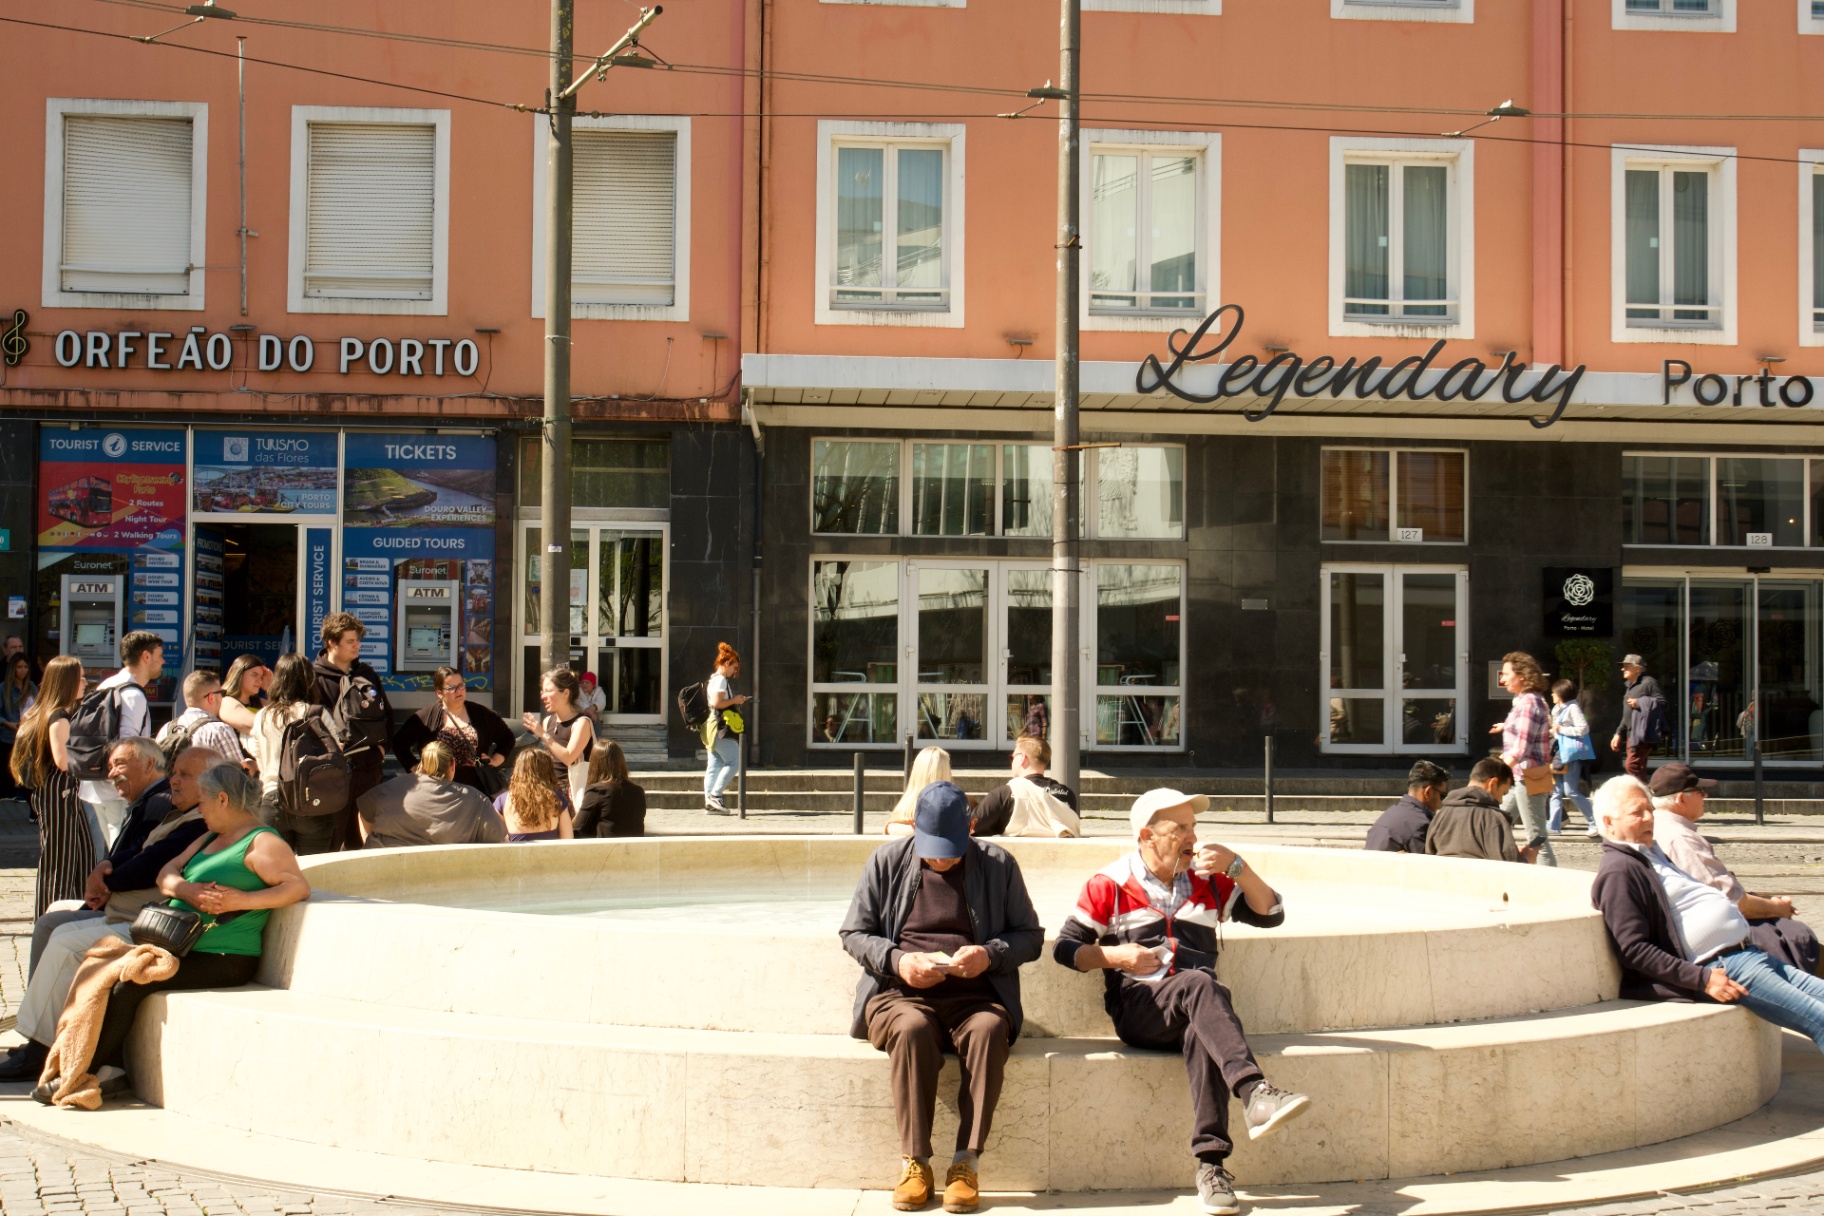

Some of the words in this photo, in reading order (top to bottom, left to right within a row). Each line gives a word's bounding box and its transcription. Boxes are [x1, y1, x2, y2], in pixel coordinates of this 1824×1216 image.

[54, 326, 233, 372] ORFEÃO
[258, 333, 314, 373] DO
[339, 336, 480, 377] PORTO
[1136, 304, 1587, 429] Legendary
[1662, 359, 1815, 409] Porto
[50, 438, 100, 450] TOURIST
[131, 440, 181, 452] SERVICE
[255, 438, 310, 452] TURISMO
[384, 444, 457, 460] TICKETS
[254, 452, 275, 463] das
[277, 453, 310, 464] Flores
[301, 493, 331, 501] PORTO
[129, 499, 135, 507] 2
[136, 499, 164, 507] Routes
[280, 501, 301, 509] CITY
[302, 501, 331, 509] TOURS
[424, 505, 456, 513] DOURO
[456, 505, 488, 514] VALLEY
[125, 515, 147, 524] Night
[430, 513, 487, 522] EXPERIENCES
[114, 531, 119, 539] 2
[121, 531, 155, 541] Walking
[155, 532, 178, 540] Tours
[1400, 530, 1418, 540] 127
[1750, 535, 1768, 545] 128
[372, 537, 421, 549] GUIDED
[424, 537, 466, 549] TOURS
[73, 560, 113, 569] Euronet
[312, 545, 325, 596] SERVICE
[409, 565, 447, 575] Euronet
[76, 583, 109, 593] ATM
[413, 588, 445, 598] ATM
[312, 598, 324, 651] TOURIST
[223, 640, 262, 650] OURIST
